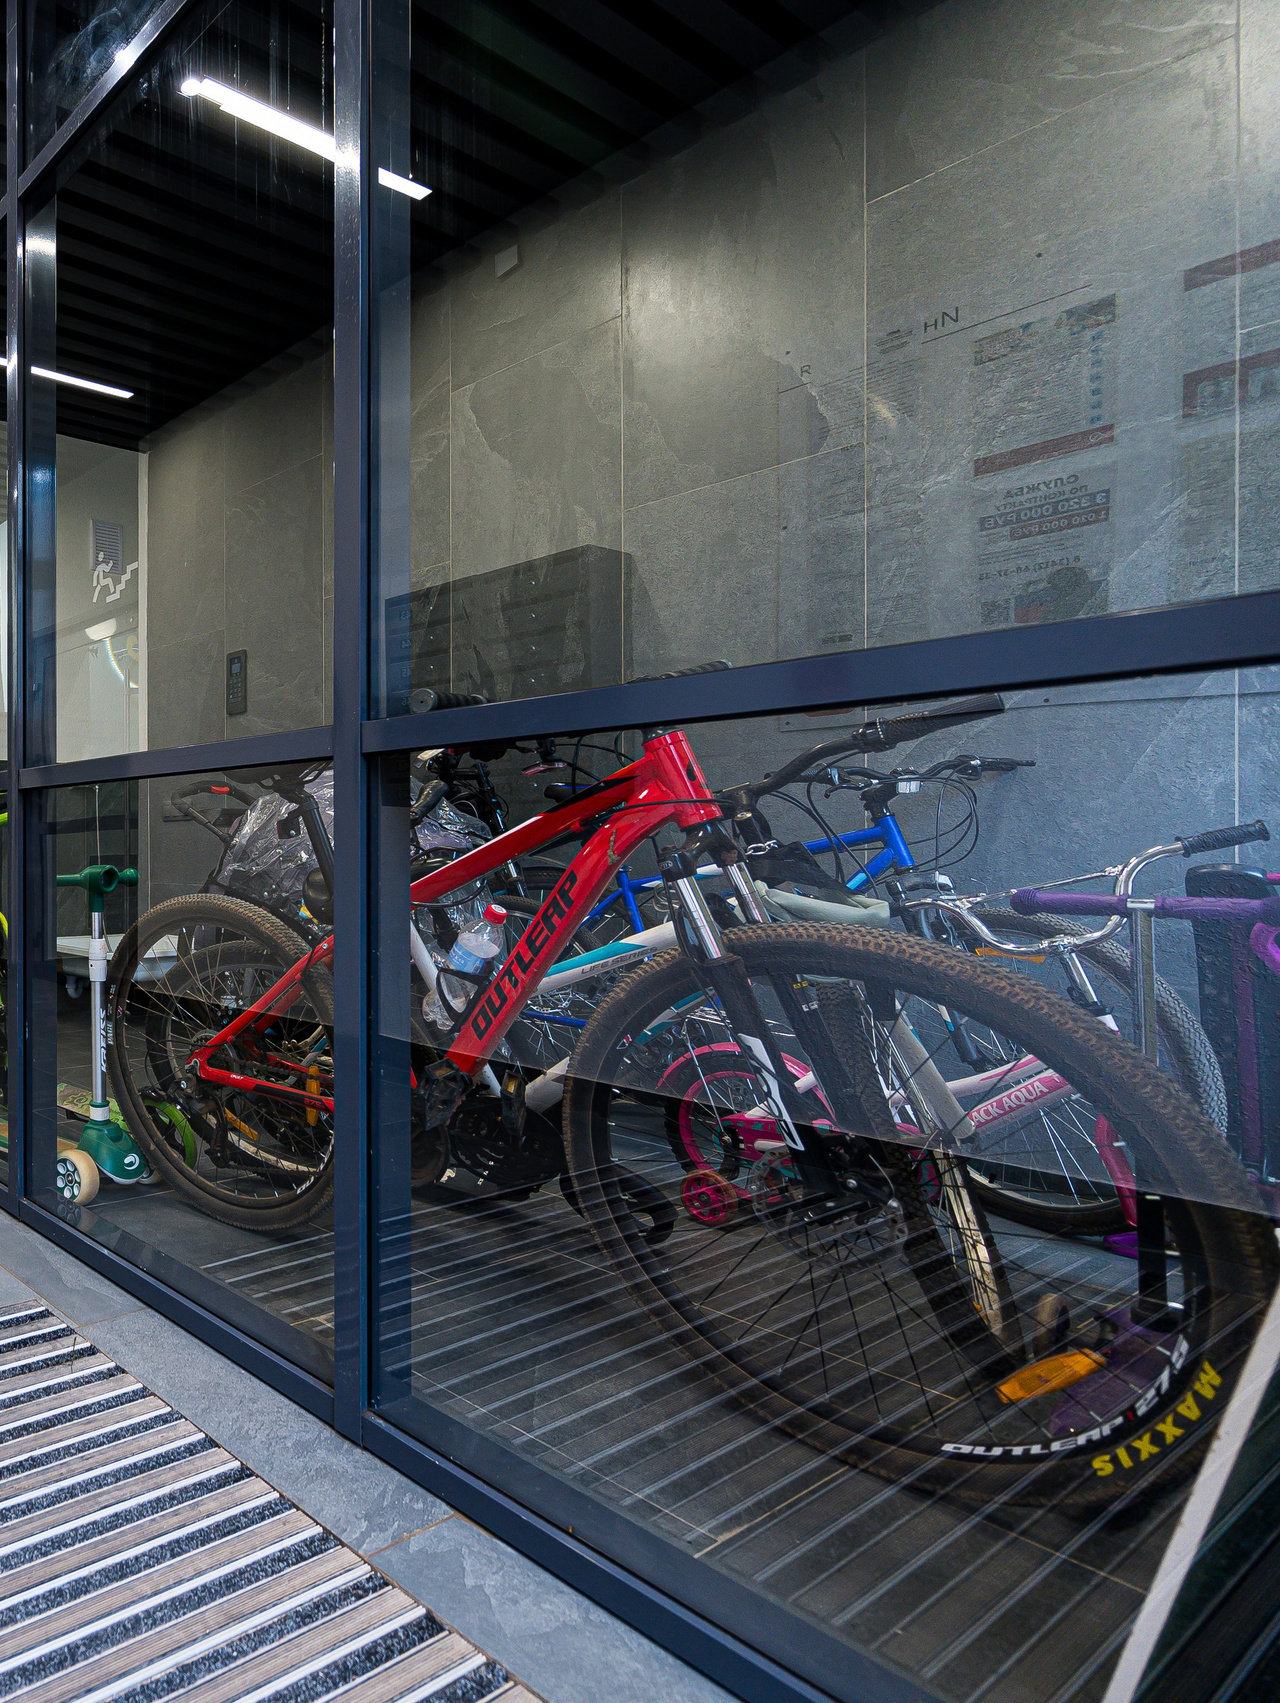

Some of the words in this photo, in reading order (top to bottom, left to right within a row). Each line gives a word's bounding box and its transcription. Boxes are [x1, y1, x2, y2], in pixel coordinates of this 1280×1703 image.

[471, 869, 578, 1041] OUTLEAP
[581, 962, 609, 974] LIFE
[611, 946, 658, 966] SERIES
[1002, 1081, 1049, 1111] AQUA
[1091, 1360, 1223, 1477] MAXXIS
[941, 1419, 1124, 1456] OUTLEAP
